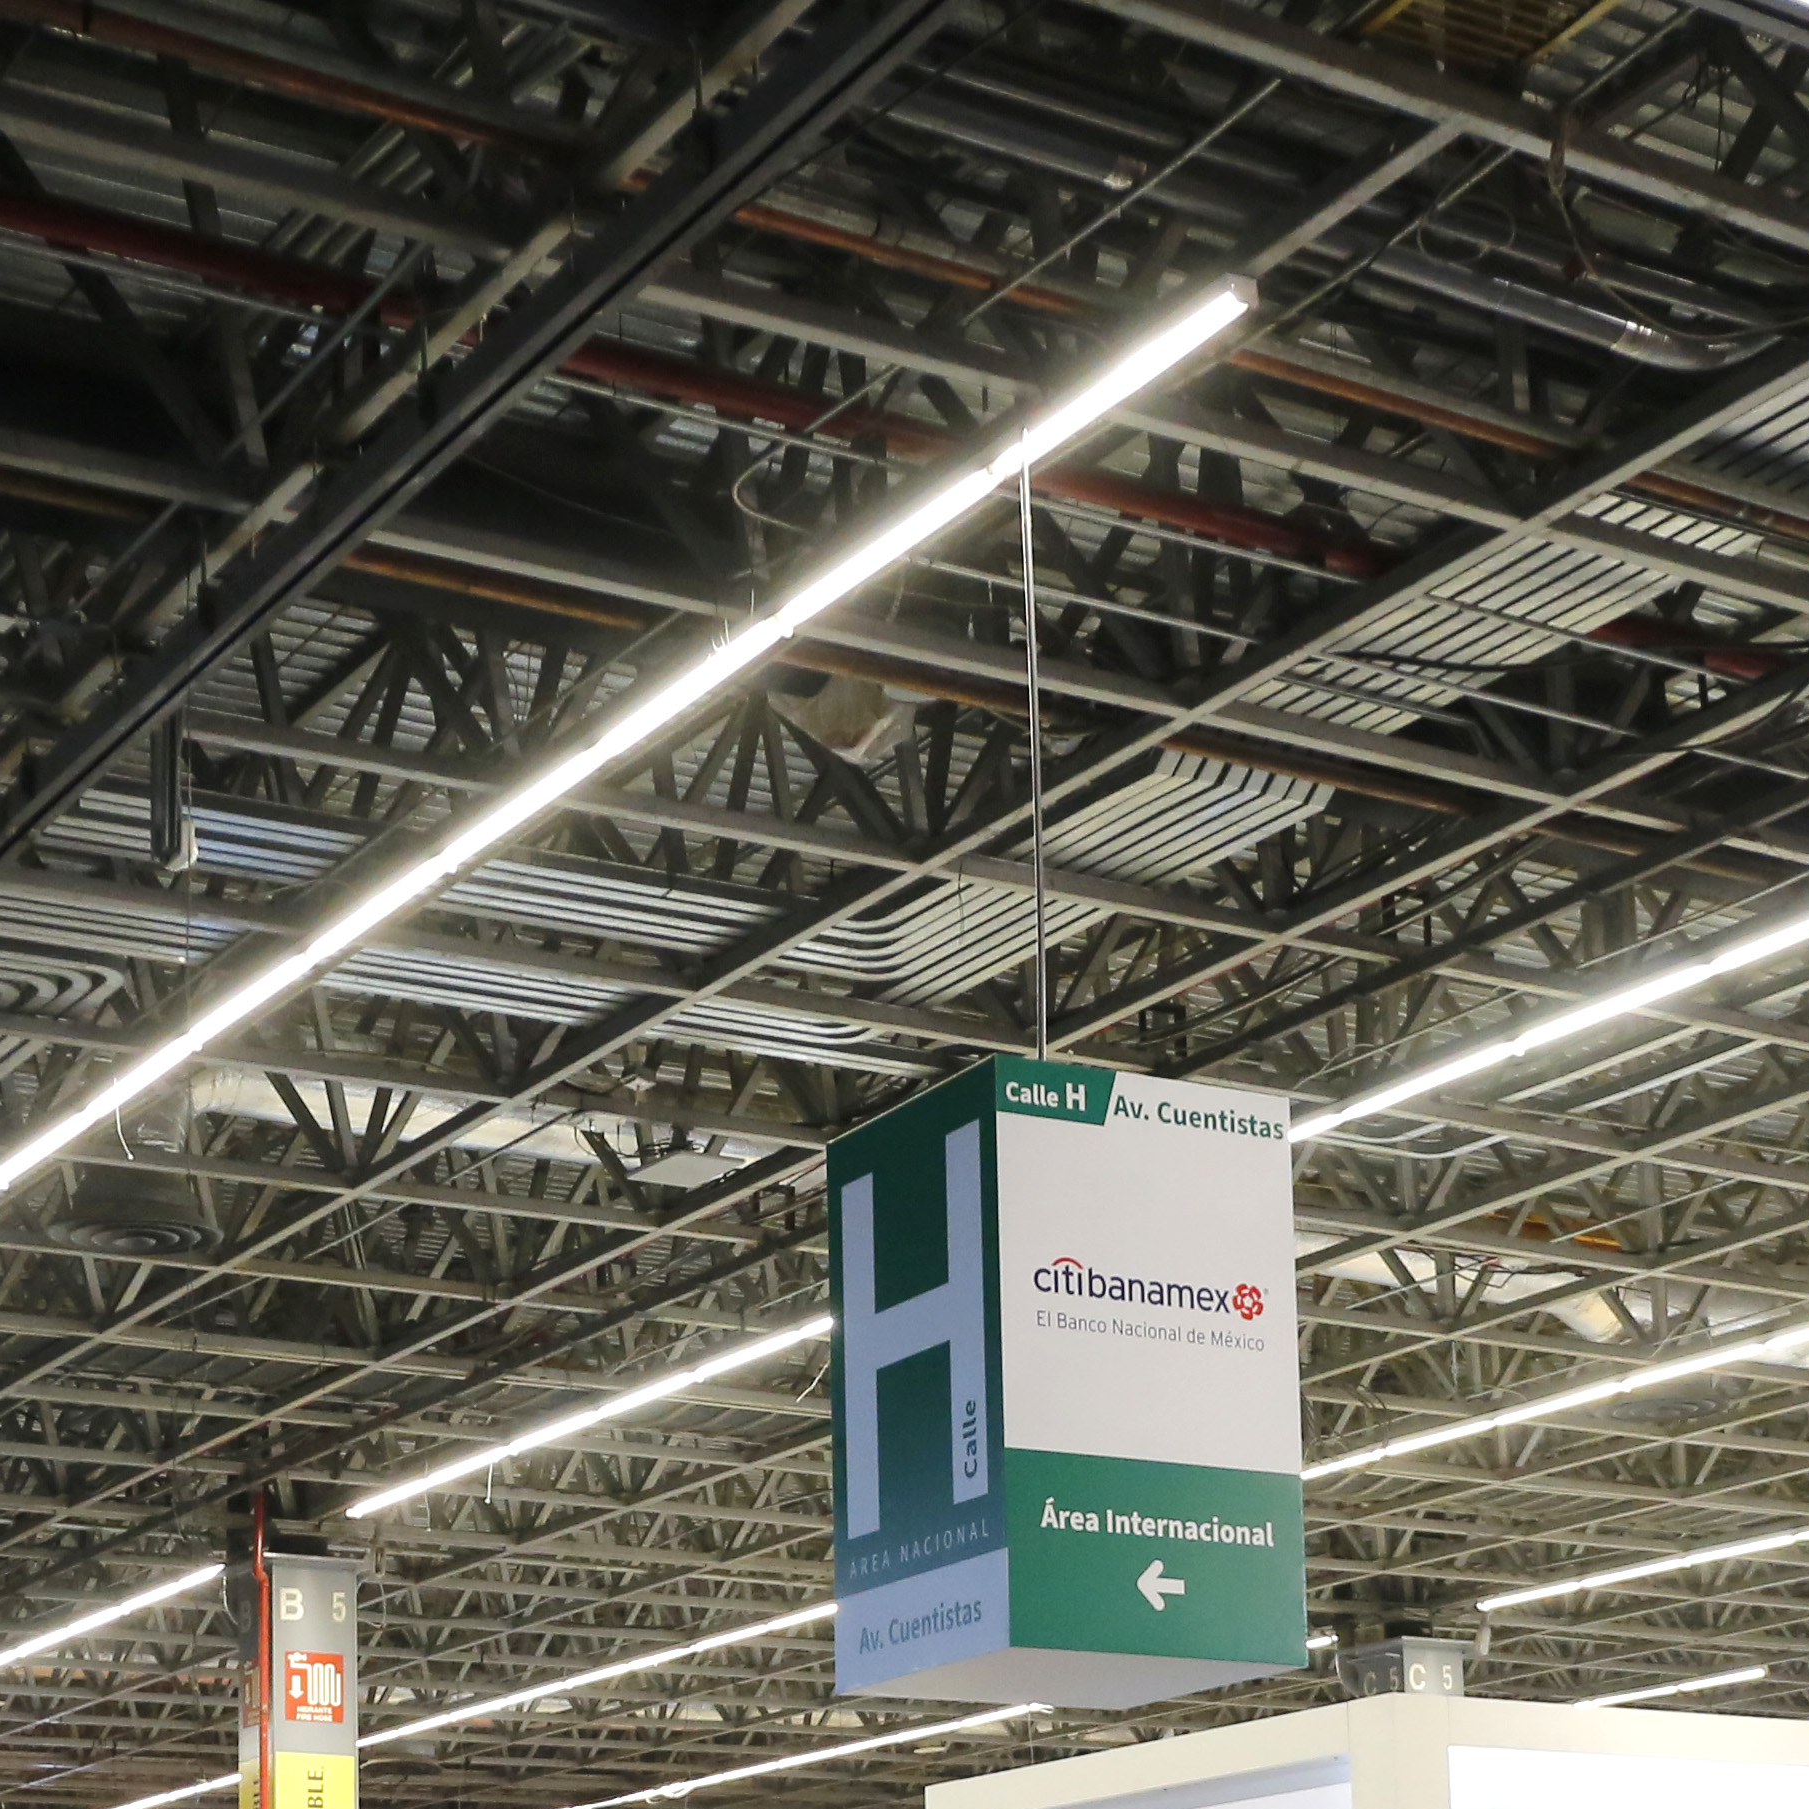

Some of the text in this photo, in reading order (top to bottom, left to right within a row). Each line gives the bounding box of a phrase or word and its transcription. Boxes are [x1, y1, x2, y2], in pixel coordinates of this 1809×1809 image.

[1006, 1080, 1086, 1111] Calle H
[1113, 1094, 1284, 1140] Av. Cuentistas
[1033, 1262, 1229, 1313] citibanamex
[841, 1118, 988, 1540] H
[1037, 1311, 1265, 1352] El Banco Nacional de México
[963, 1399, 976, 1480] Calle
[900, 1522, 989, 1563] NACIONAL
[1040, 1497, 1274, 1547] Área Internacional
[279, 1587, 303, 1621] B
[332, 1592, 346, 1622] 5
[860, 1600, 982, 1654] Av. Cuentistas
[1409, 1663, 1453, 1690] C 5
